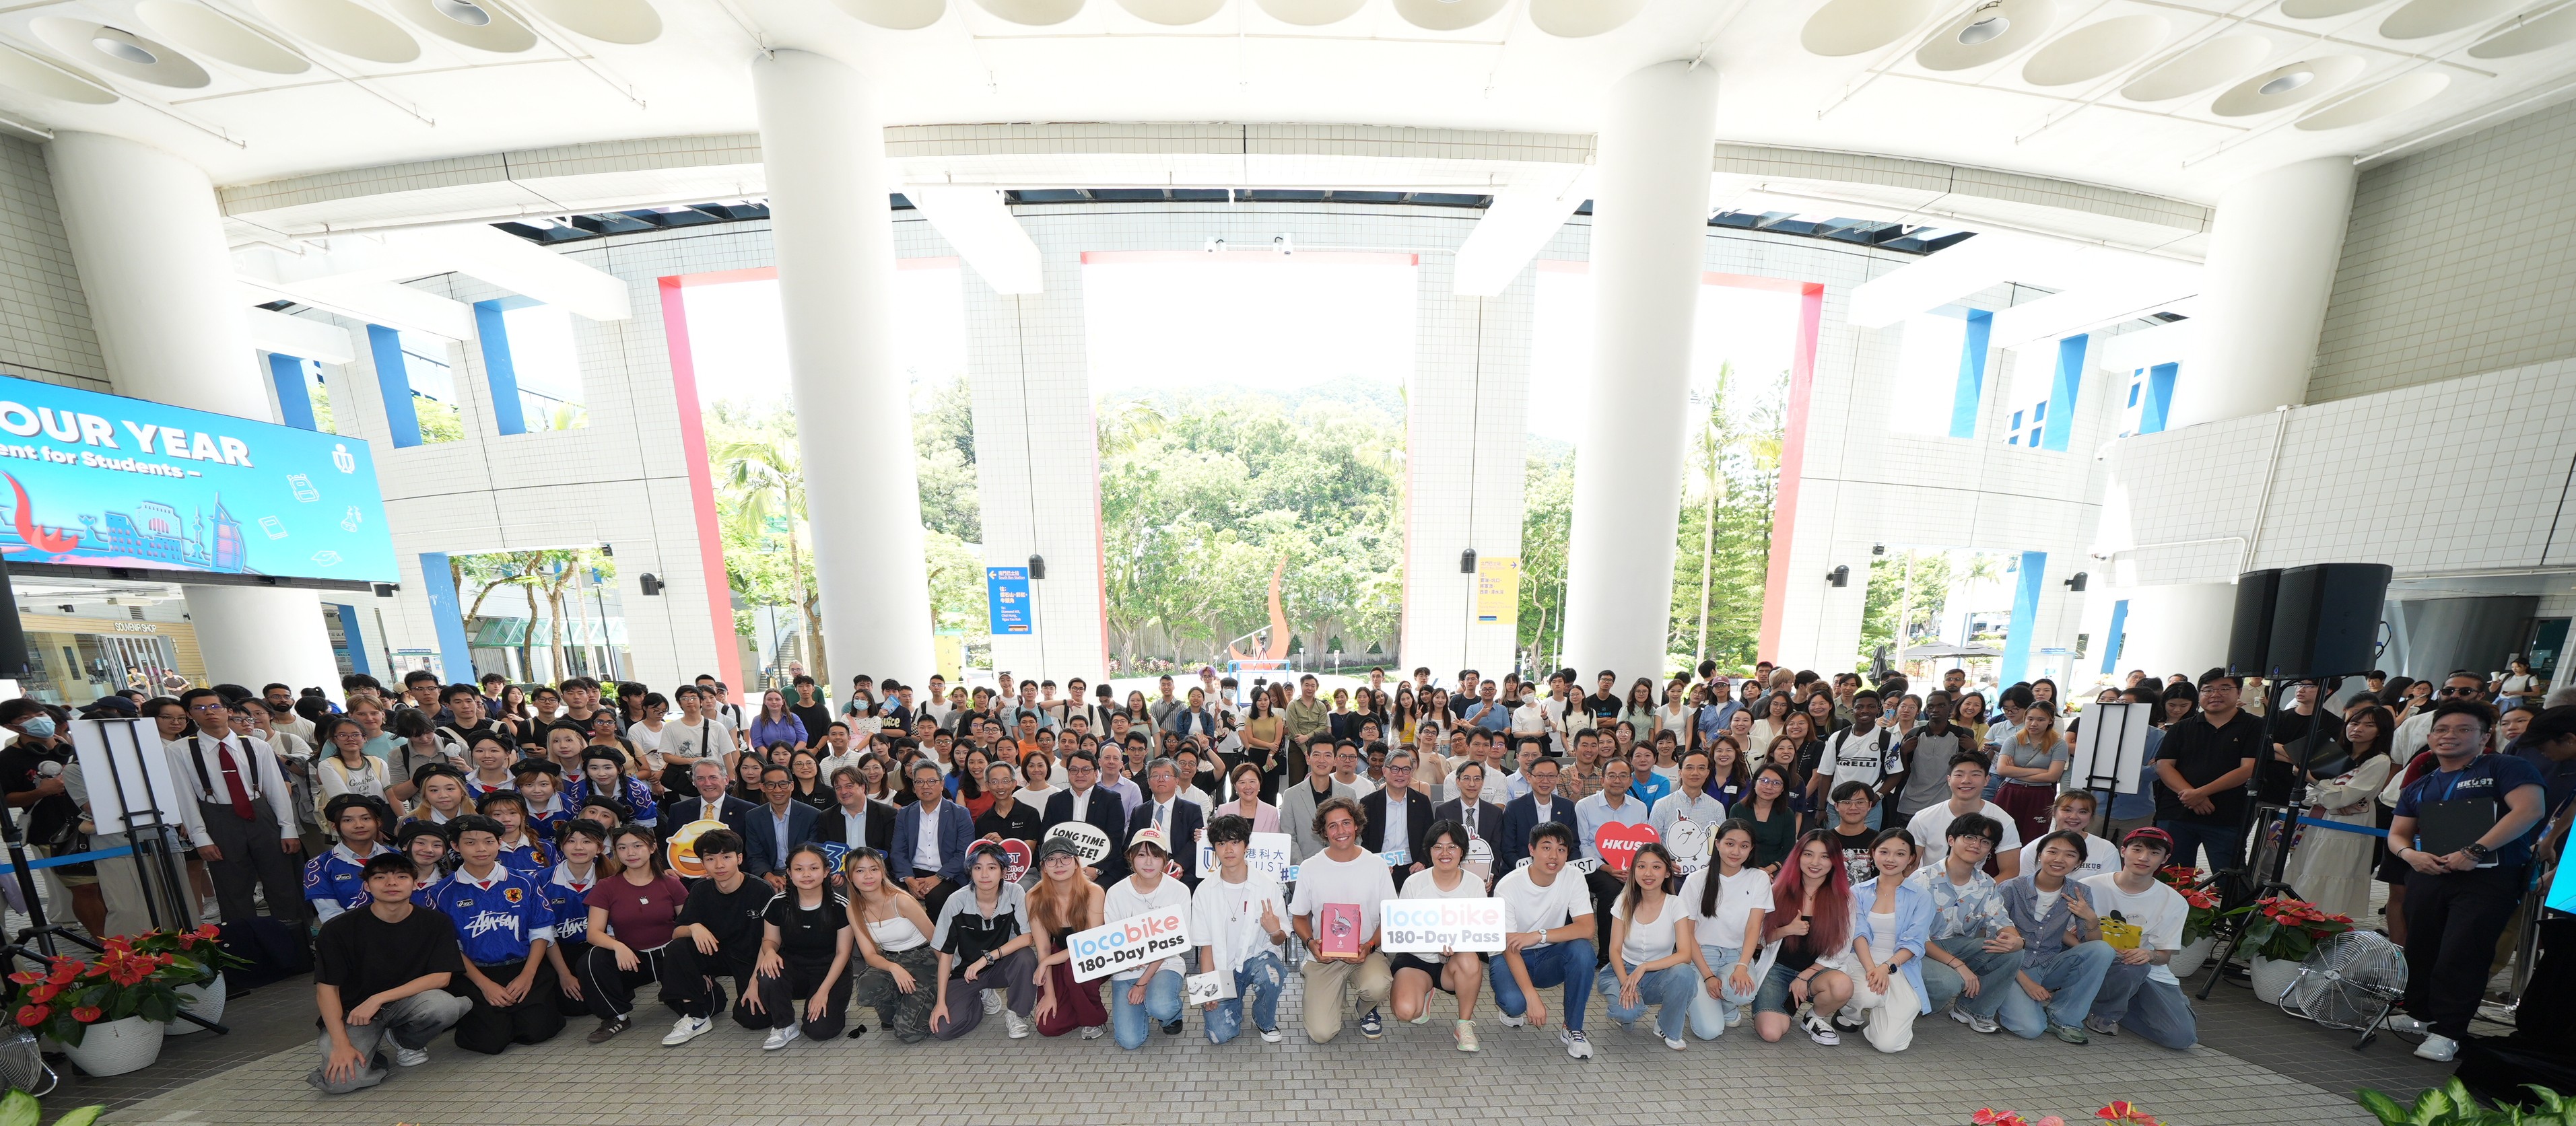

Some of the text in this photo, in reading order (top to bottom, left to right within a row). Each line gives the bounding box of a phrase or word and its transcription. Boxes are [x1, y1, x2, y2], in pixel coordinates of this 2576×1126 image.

[121, 420, 255, 468] YEAR
[40, 446, 79, 465] for
[80, 451, 184, 478] Students
[114, 623, 157, 633] SOUVENIR SHOP
[1052, 828, 1106, 847] LONG TIME
[1602, 839, 1653, 851] HKUS
[1386, 904, 1499, 927] locobike
[1073, 915, 1180, 958] locobike
[1387, 930, 1500, 946] 180-Day Pass
[1078, 935, 1185, 973] 180-Day Pass
